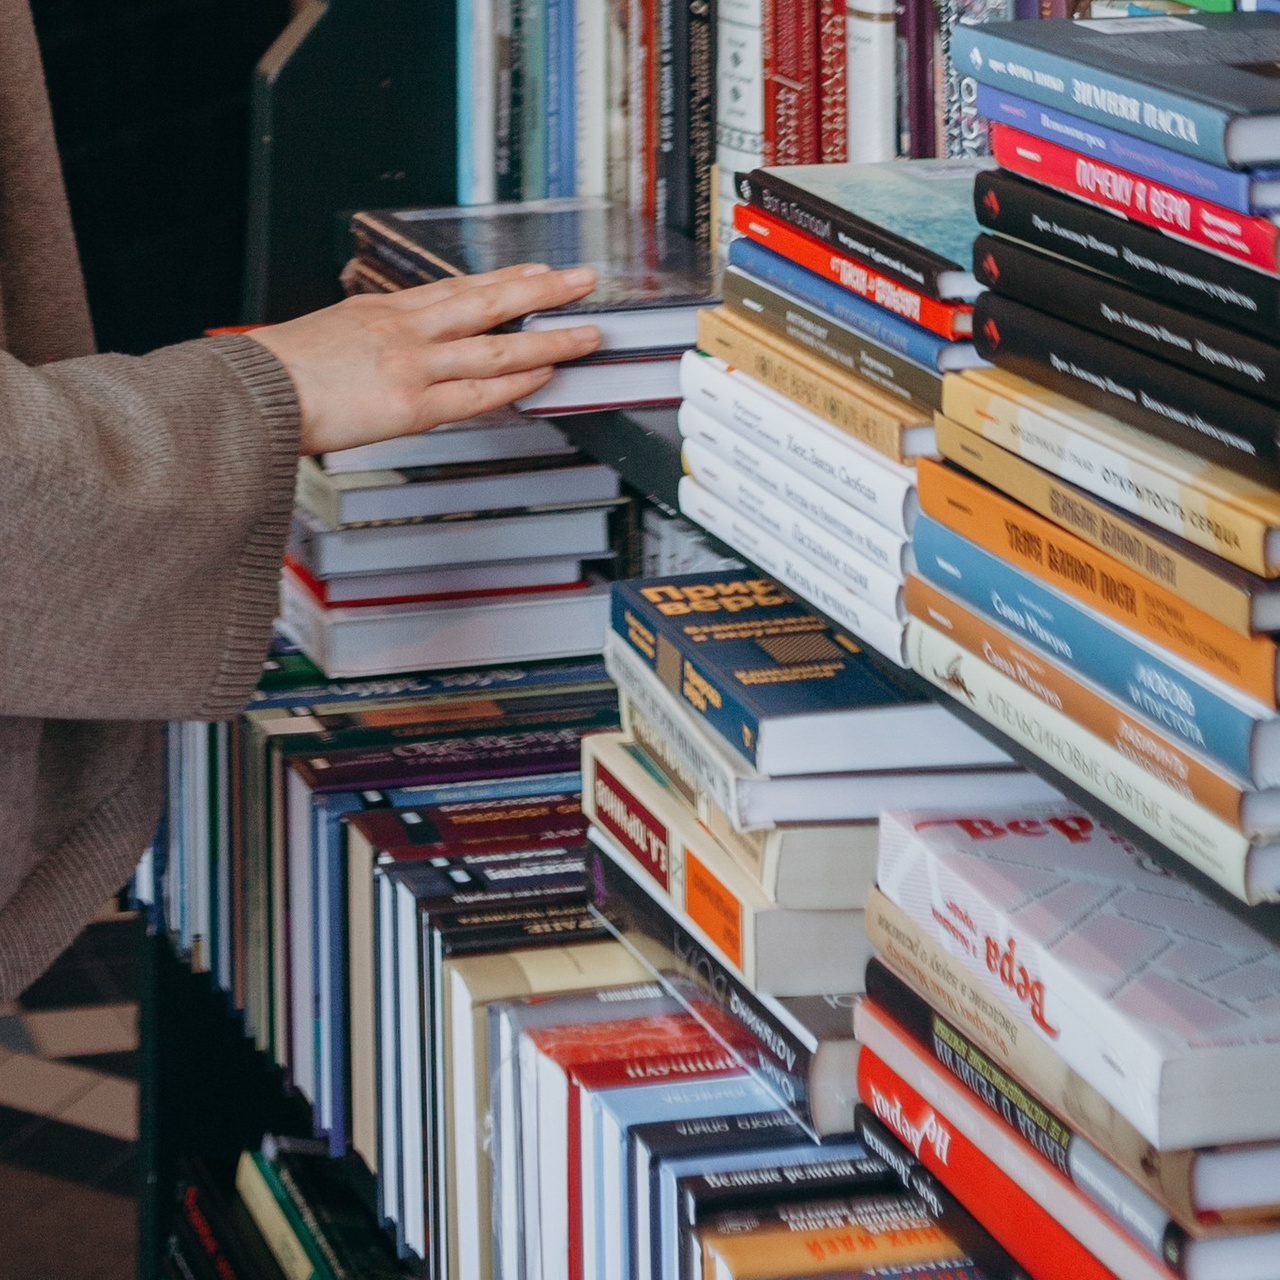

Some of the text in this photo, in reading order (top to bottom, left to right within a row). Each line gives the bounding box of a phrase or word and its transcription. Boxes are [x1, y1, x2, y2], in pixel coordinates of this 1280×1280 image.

[1071, 77, 1200, 146] ЗИМНЯЯ ПАСХА
[1076, 157, 1191, 231] ПОЧЕМУ Я ВЕРЮ
[1102, 459, 1241, 551] ОТКРЫТОСТЬ СЕРДЦА
[1048, 543, 1137, 616] ВЕЛИКОГО ПОСТА
[990, 590, 1073, 659] Савва Мажуко
[981, 640, 1063, 710] Савва Мажуко
[1135, 663, 1196, 717] ЛЮБОВЬ
[1118, 718, 1189, 780] ЛАБИРИНТЫ
[1140, 691, 1207, 748] ПУСТОТА
[986, 691, 1163, 826] АПЕЛЬСИНОВЫЕ СВЯТЫЕ
[595, 772, 667, 876] Е.А. ТОРЧИНОВ
[914, 814, 1095, 843] Вер
[877, 913, 918, 959] религии
[929, 956, 958, 991] науку
[985, 935, 1059, 1038] Вера
[730, 992, 796, 1073] Латынина
[967, 988, 1019, 1045] Введение
[871, 1085, 950, 1166] Не верю!
[933, 1032, 1066, 1174] НАУКА О РЕЛИГИИ
[703, 1167, 782, 1189] Великие
[784, 1163, 857, 1185] религии
[862, 1125, 942, 1221] «Бог» Докинза
